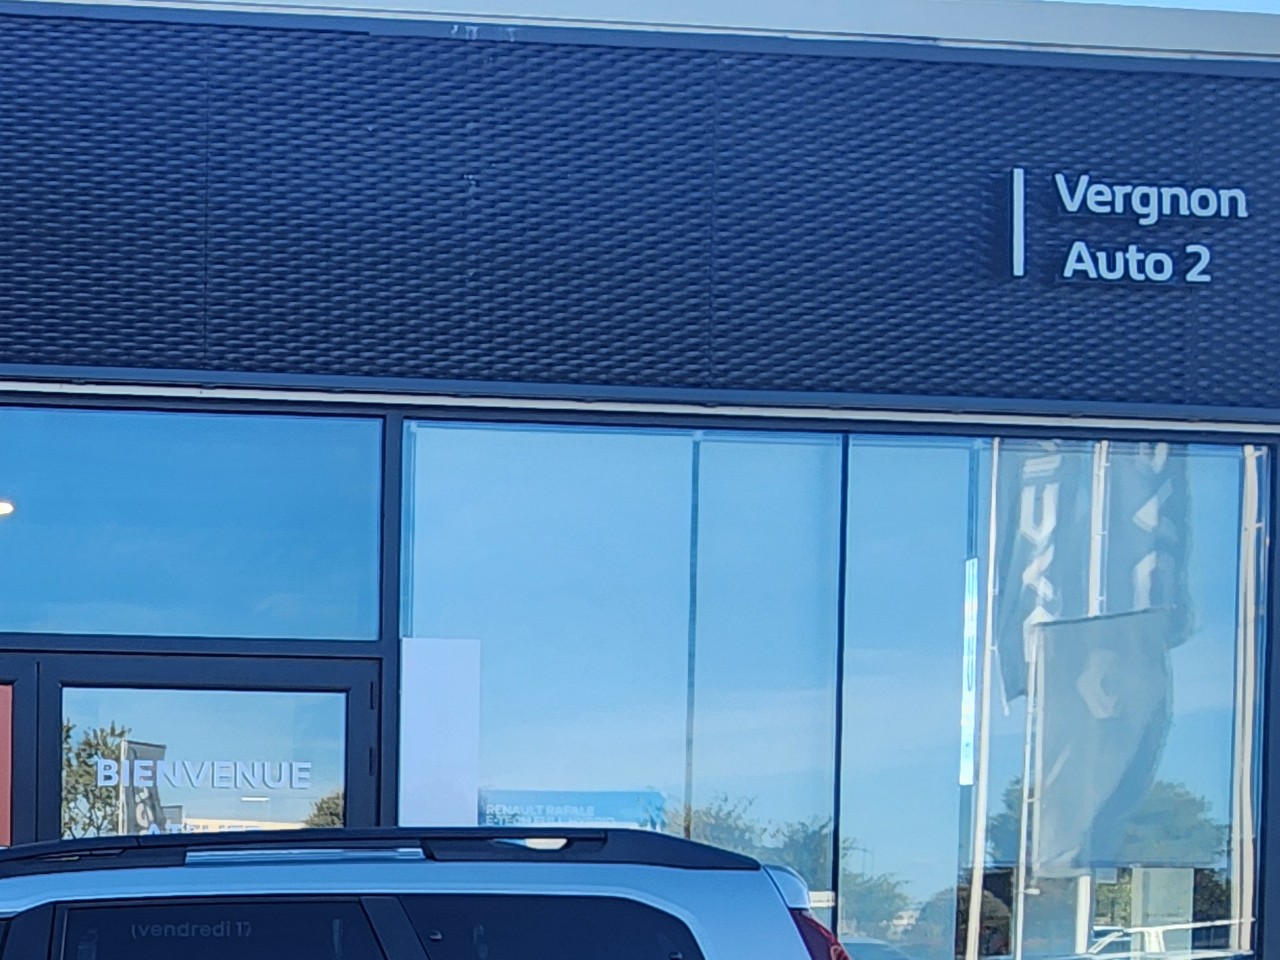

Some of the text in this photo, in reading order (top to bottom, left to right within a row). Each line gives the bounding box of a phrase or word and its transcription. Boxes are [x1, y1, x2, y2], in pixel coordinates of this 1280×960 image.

[1055, 173, 1248, 225] Vergnon
[1063, 241, 1211, 282] Auto 2
[96, 759, 312, 789] BIENVENUE
